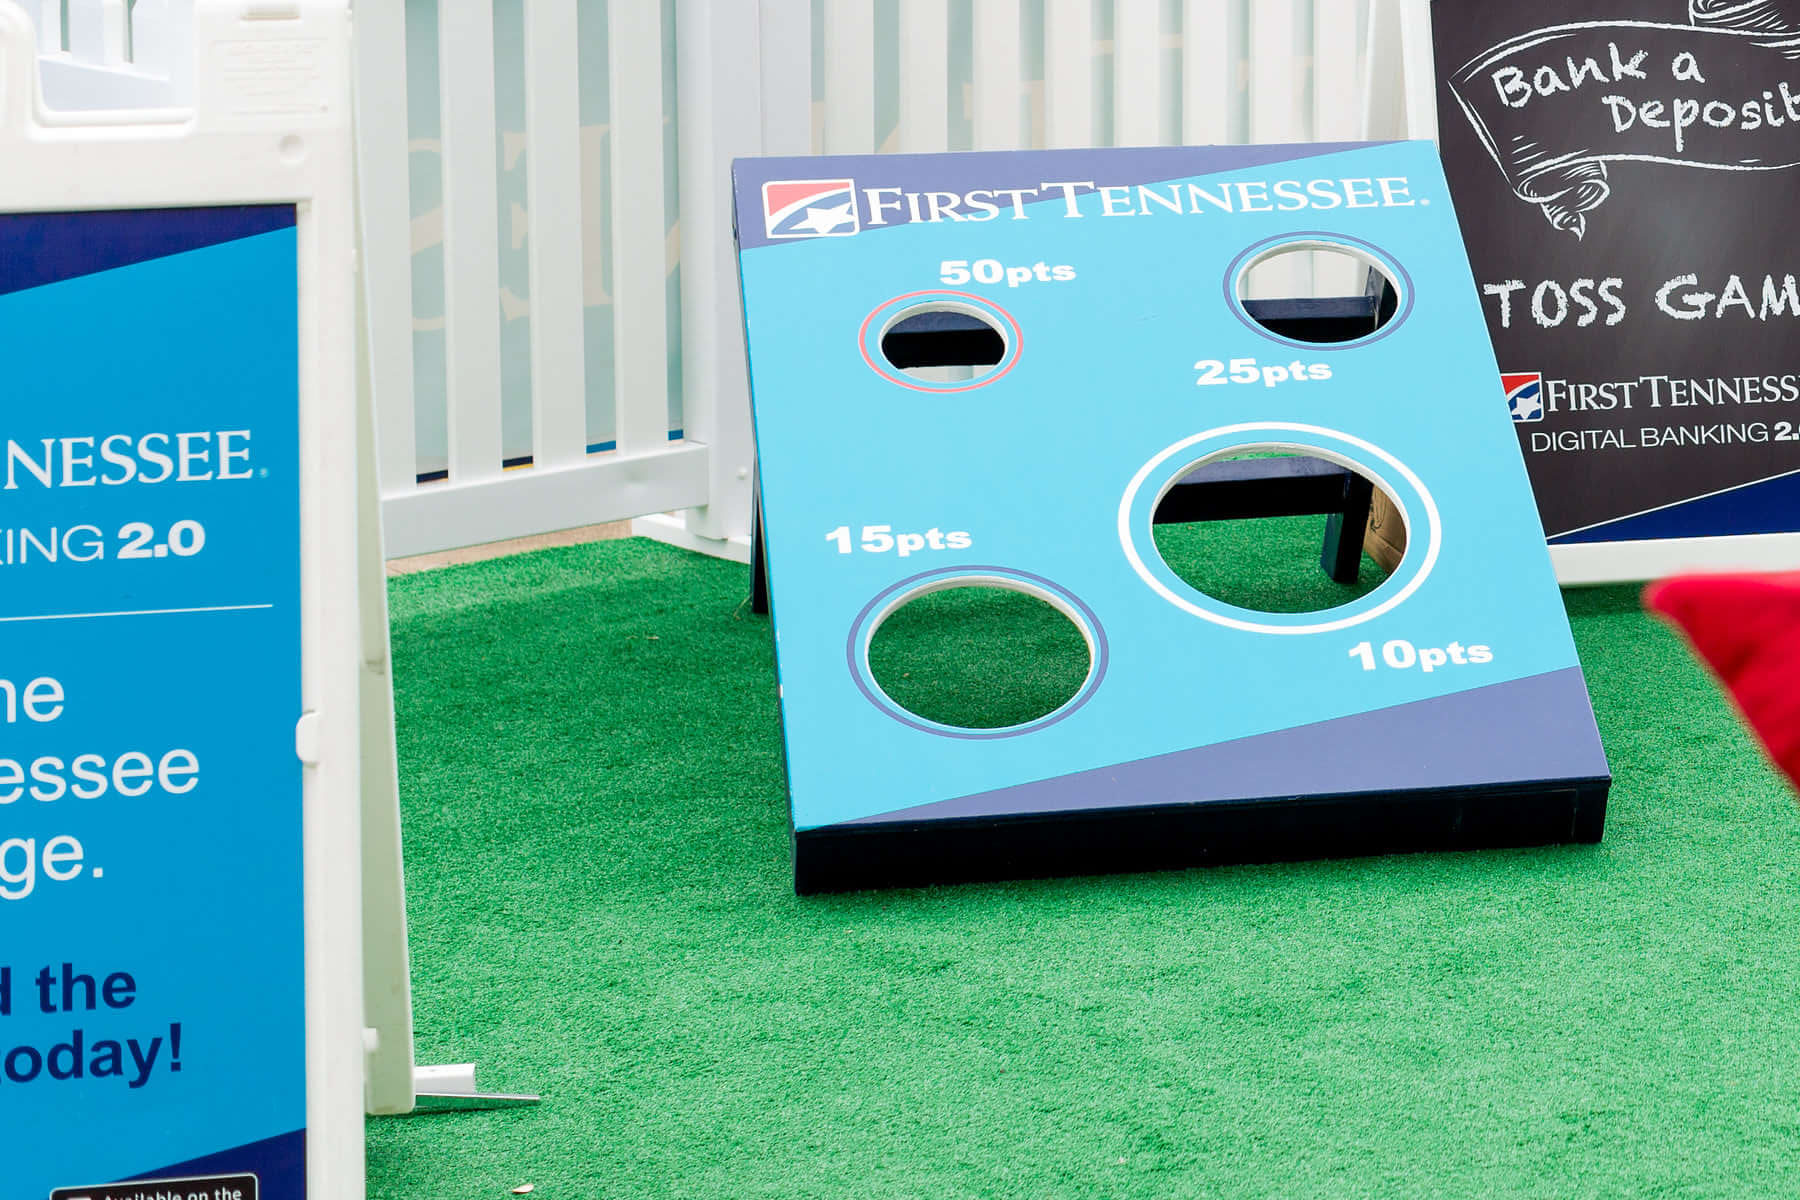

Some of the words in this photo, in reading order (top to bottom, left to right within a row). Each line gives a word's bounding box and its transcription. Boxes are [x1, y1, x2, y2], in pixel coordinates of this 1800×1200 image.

[1492, 42, 1649, 108] Bank
[1671, 50, 1706, 84] a
[862, 186, 1040, 225] FIRST
[1040, 176, 1417, 219] TENNESSEE
[939, 258, 1078, 288] 50pts
[1483, 277, 1627, 329] TOSS
[1193, 357, 1334, 388] 25pts
[1545, 379, 1640, 413] FIRST
[1530, 430, 1636, 453] DIGITAL
[1640, 422, 1769, 448] BANKING
[0, 524, 104, 565] ING
[117, 519, 206, 560] 2.0
[824, 525, 973, 554] 15pts
[1347, 639, 1494, 673] 10pts
[35, 962, 137, 1014] the
[0, 1022, 182, 1089] oday!
